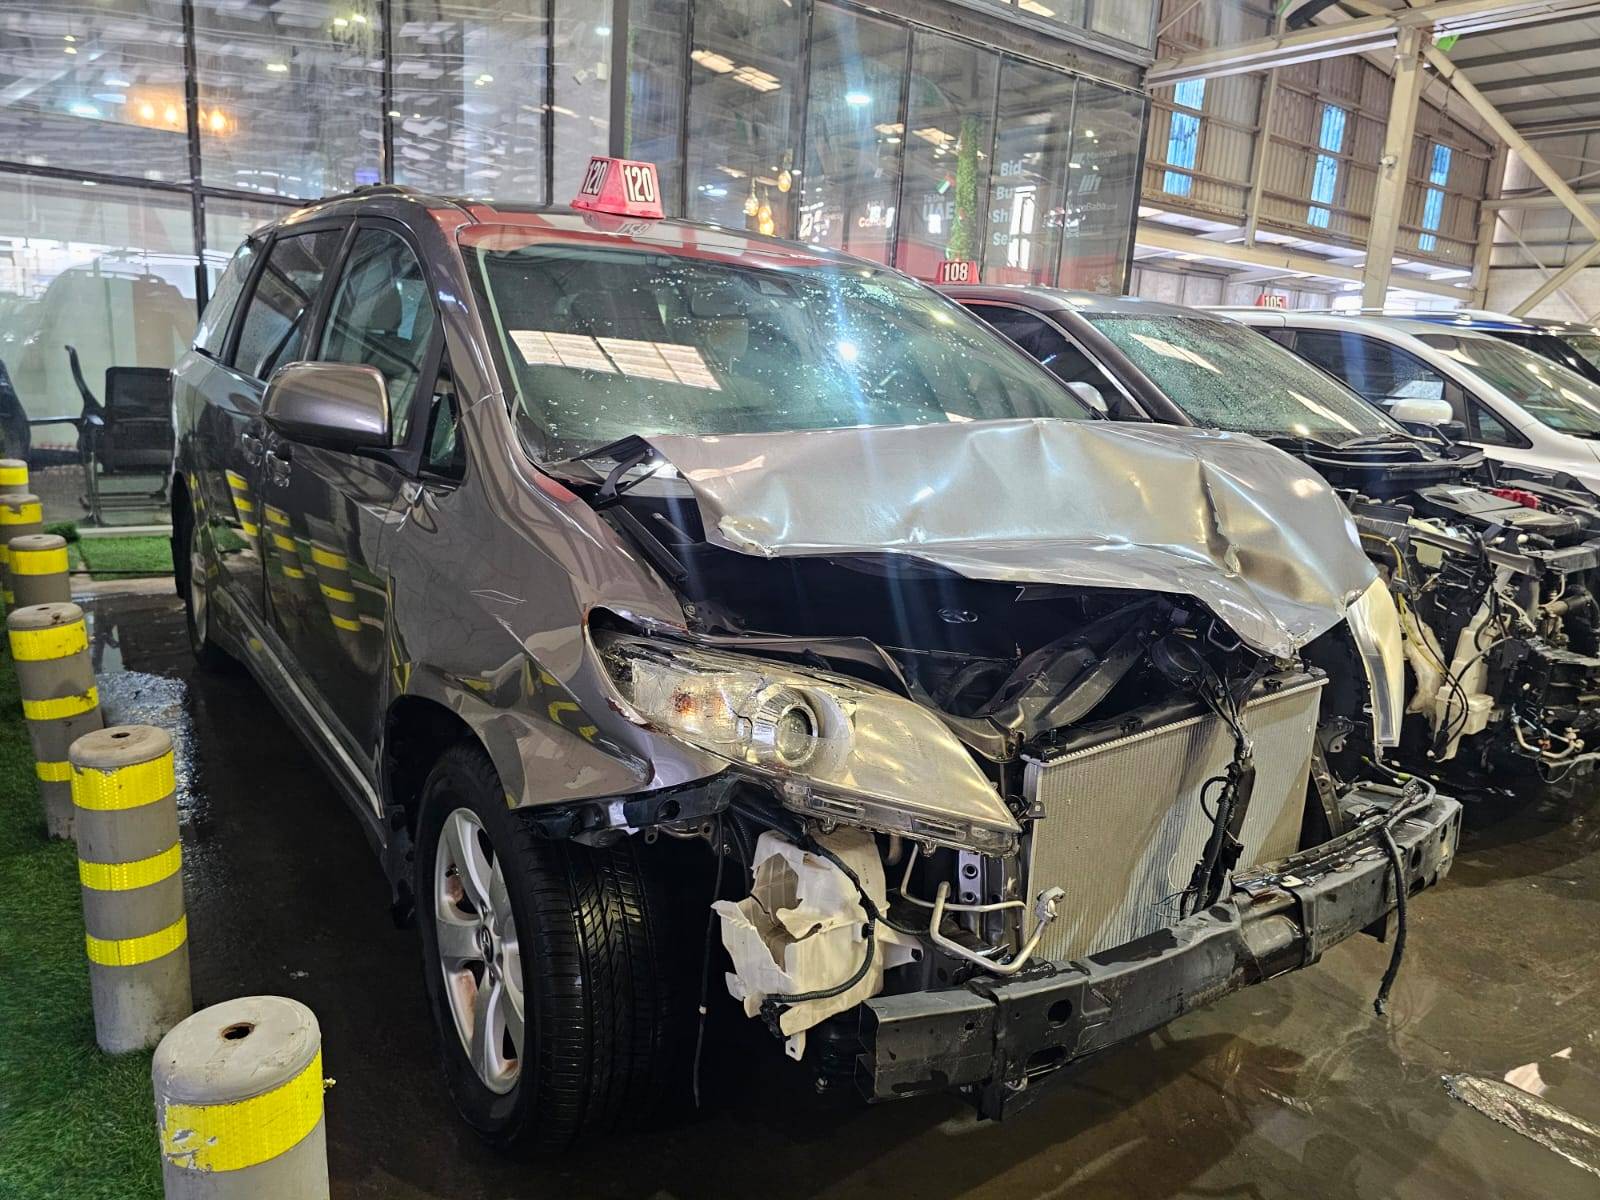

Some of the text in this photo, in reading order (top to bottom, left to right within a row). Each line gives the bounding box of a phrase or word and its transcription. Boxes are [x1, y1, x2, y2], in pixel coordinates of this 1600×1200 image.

[583, 160, 608, 195] 120
[1001, 160, 1022, 177] Bid
[624, 165, 655, 202] 120
[922, 202, 955, 220] UAE
[944, 262, 969, 281] 108
[1265, 296, 1283, 309] 105
